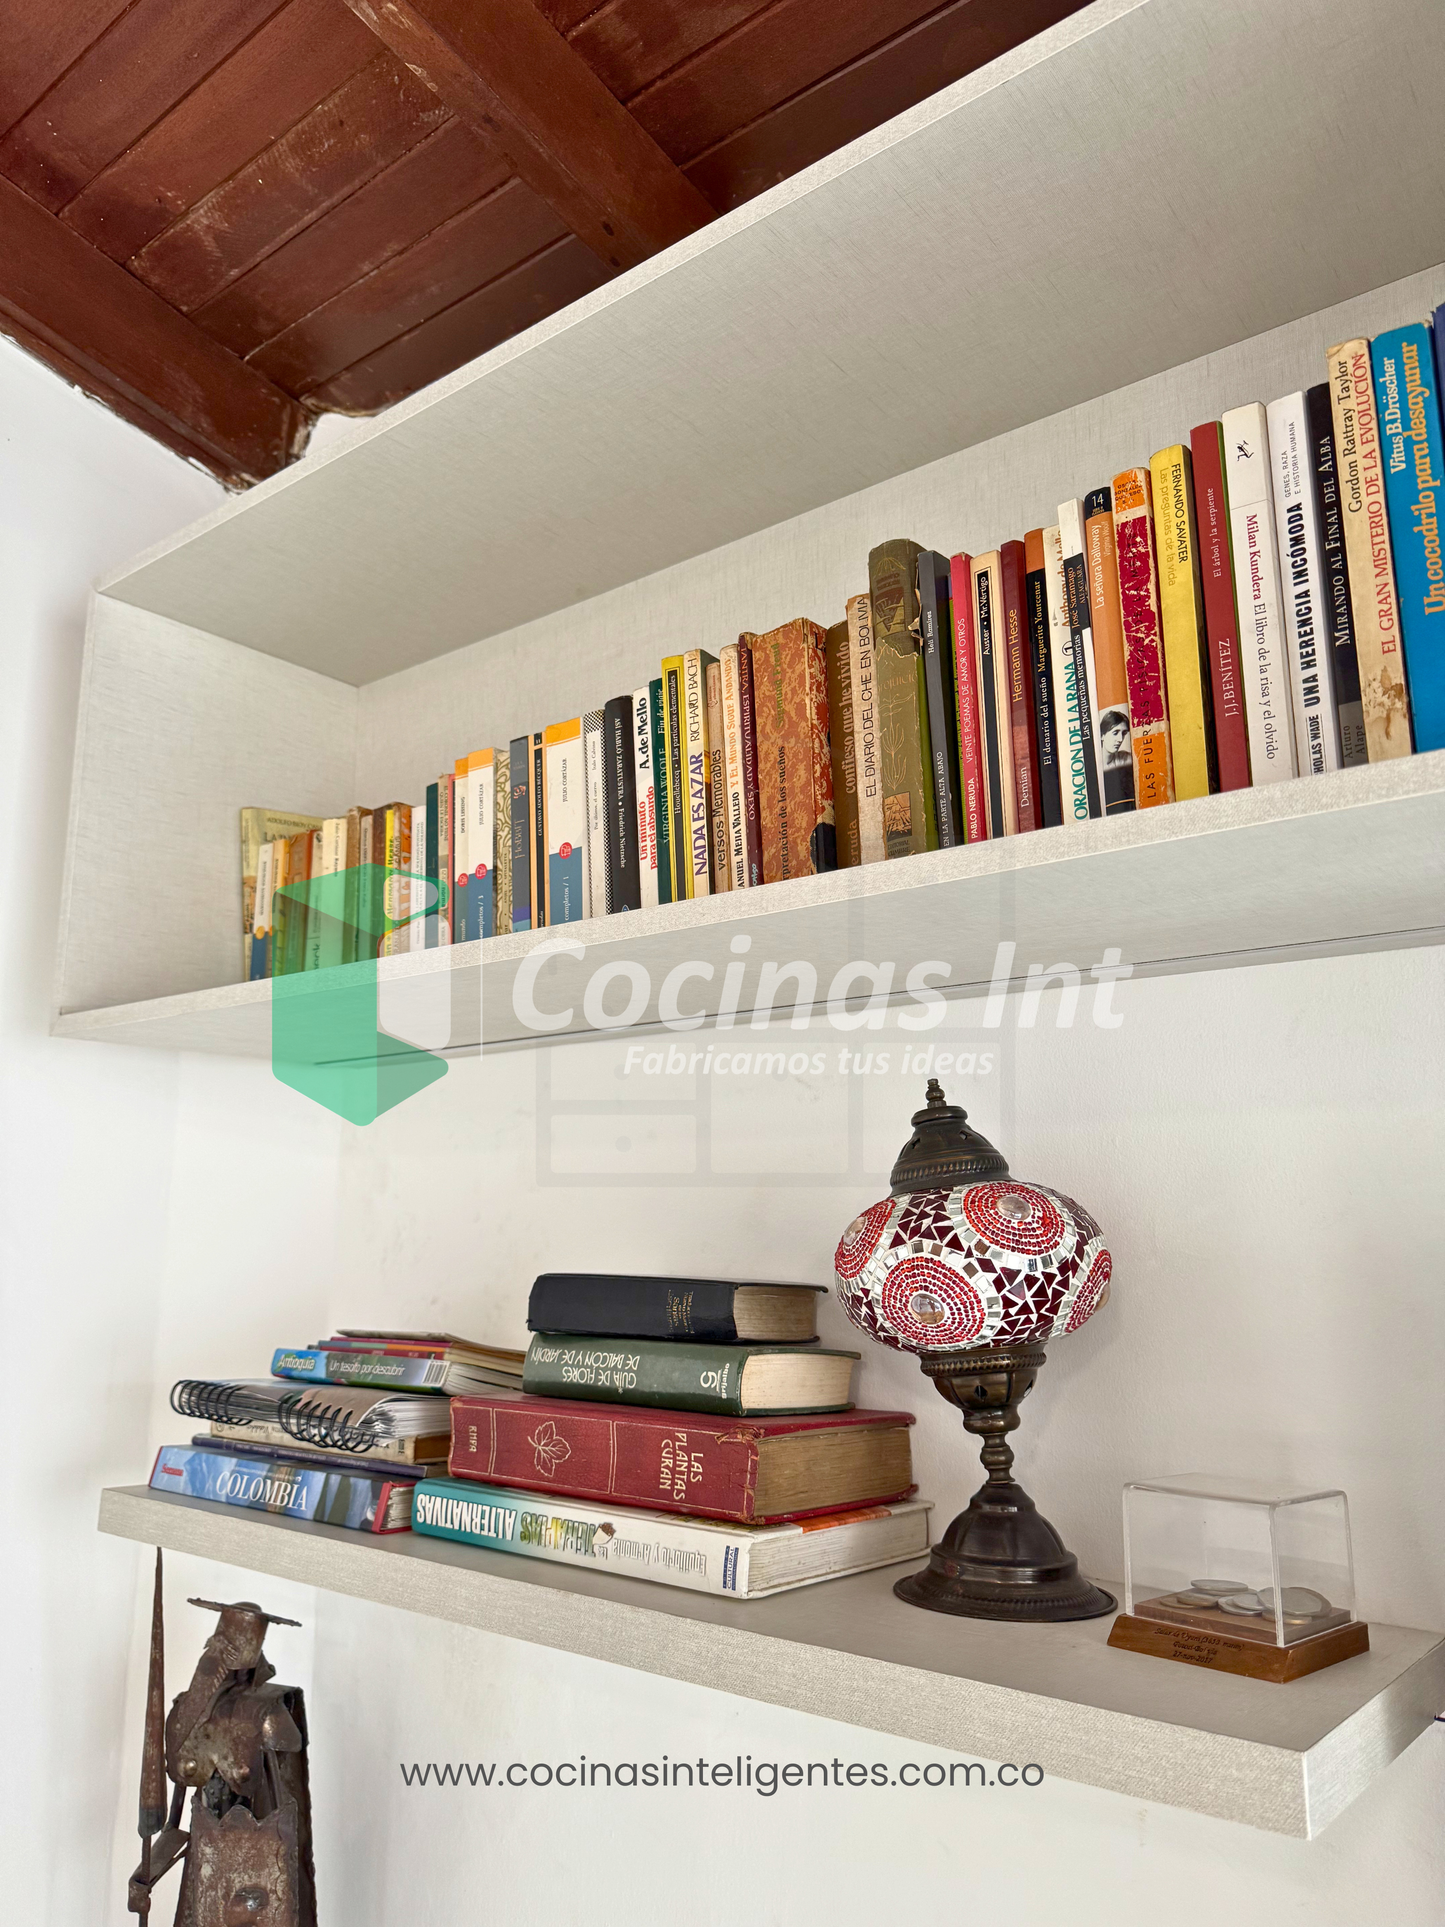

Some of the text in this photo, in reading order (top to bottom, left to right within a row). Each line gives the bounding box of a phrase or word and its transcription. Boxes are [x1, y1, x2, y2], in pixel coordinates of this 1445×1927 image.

[1289, 421, 1297, 455] HUMANA
[1335, 361, 1362, 514] Gordon Rattray Taylor
[1390, 434, 1406, 475] Vitus
[1292, 456, 1301, 488] HISTORIA
[1402, 343, 1445, 615] Un cocodrilo para desayunar
[1091, 494, 1104, 507] 14
[1171, 463, 1188, 563] FERNANDO SAVATER
[1207, 488, 1217, 526] serpiente
[1352, 353, 1397, 655] EL GRAN MISTERIO DE LA EVOLUCIÓN
[1091, 524, 1102, 567] Dalloway
[1160, 468, 1177, 587] Las preguntas de la vida
[1209, 527, 1217, 536] la
[1210, 542, 1221, 565] árbol
[1213, 567, 1221, 578] El
[1246, 514, 1264, 601] Milan Kundera
[1066, 567, 1079, 629] José Saramago
[1075, 564, 1086, 605] ALFAGUARA
[1092, 567, 1104, 595] señora
[1034, 581, 1043, 623] Yourcenar
[1095, 596, 1105, 610] La
[1286, 502, 1321, 708] UNA HERENCIA INCÓMODA
[957, 618, 966, 647] OTROS
[983, 628, 991, 655] Auster
[1035, 623, 1048, 673] Marguerite
[960, 656, 969, 683] AMOR
[1008, 609, 1023, 703] Hermann Hesse
[668, 674, 676, 713] elementales
[686, 657, 700, 742] RICHARD BACH
[857, 596, 877, 798] EL DIARIO DEL CHE EN BOLIVIA
[962, 684, 970, 697] DE
[1074, 634, 1091, 740] Las pequeñas memorias
[1254, 603, 1278, 760] El libro de la risa y el olvido
[636, 697, 650, 740] Mello
[775, 681, 785, 729] Sigmund
[836, 641, 857, 794] confieso que he vivido
[962, 697, 972, 736] POEMAS
[1041, 701, 1050, 718] del
[672, 748, 680, 761] Las
[964, 736, 973, 763] VEINTE
[1042, 720, 1051, 758] denario
[1310, 714, 1324, 776] HOLAS WADE
[1344, 725, 1354, 759] Arturo
[1355, 725, 1366, 754] Alape
[615, 755, 625, 799] ZARATUSTRA
[1043, 758, 1052, 766] El
[968, 777, 976, 811] NERUDA
[1020, 766, 1030, 808] Demian
[645, 785, 659, 870] para el absurdo
[689, 751, 708, 877] NADA ES AZAR
[710, 748, 726, 872] versos Memorables
[777, 745, 791, 880] rpretación de los sueños
[618, 808, 627, 868] Friedrich Nietzsche
[638, 801, 648, 861] Un minuto
[277, 1354, 316, 1373] Antioquia
[329, 1360, 339, 1371] Un
[360, 1363, 373, 1376] por
[373, 1363, 406, 1377] descubrir
[531, 1346, 640, 1370] DE BALCÓN Y DE JARDÍN
[562, 1365, 595, 1385] FLORES
[598, 1369, 612, 1386] DE
[721, 1362, 731, 1399] grijalbo
[659, 1438, 673, 1490] CURAN
[673, 1432, 688, 1500] PLANTAS
[689, 1452, 704, 1483] LAS
[416, 1493, 517, 1542] ALTERNATIVAS
[520, 1511, 598, 1557] TERAPIAS
[661, 1546, 707, 1577] Equilibrio
[726, 1548, 735, 1590] CULTURAL
